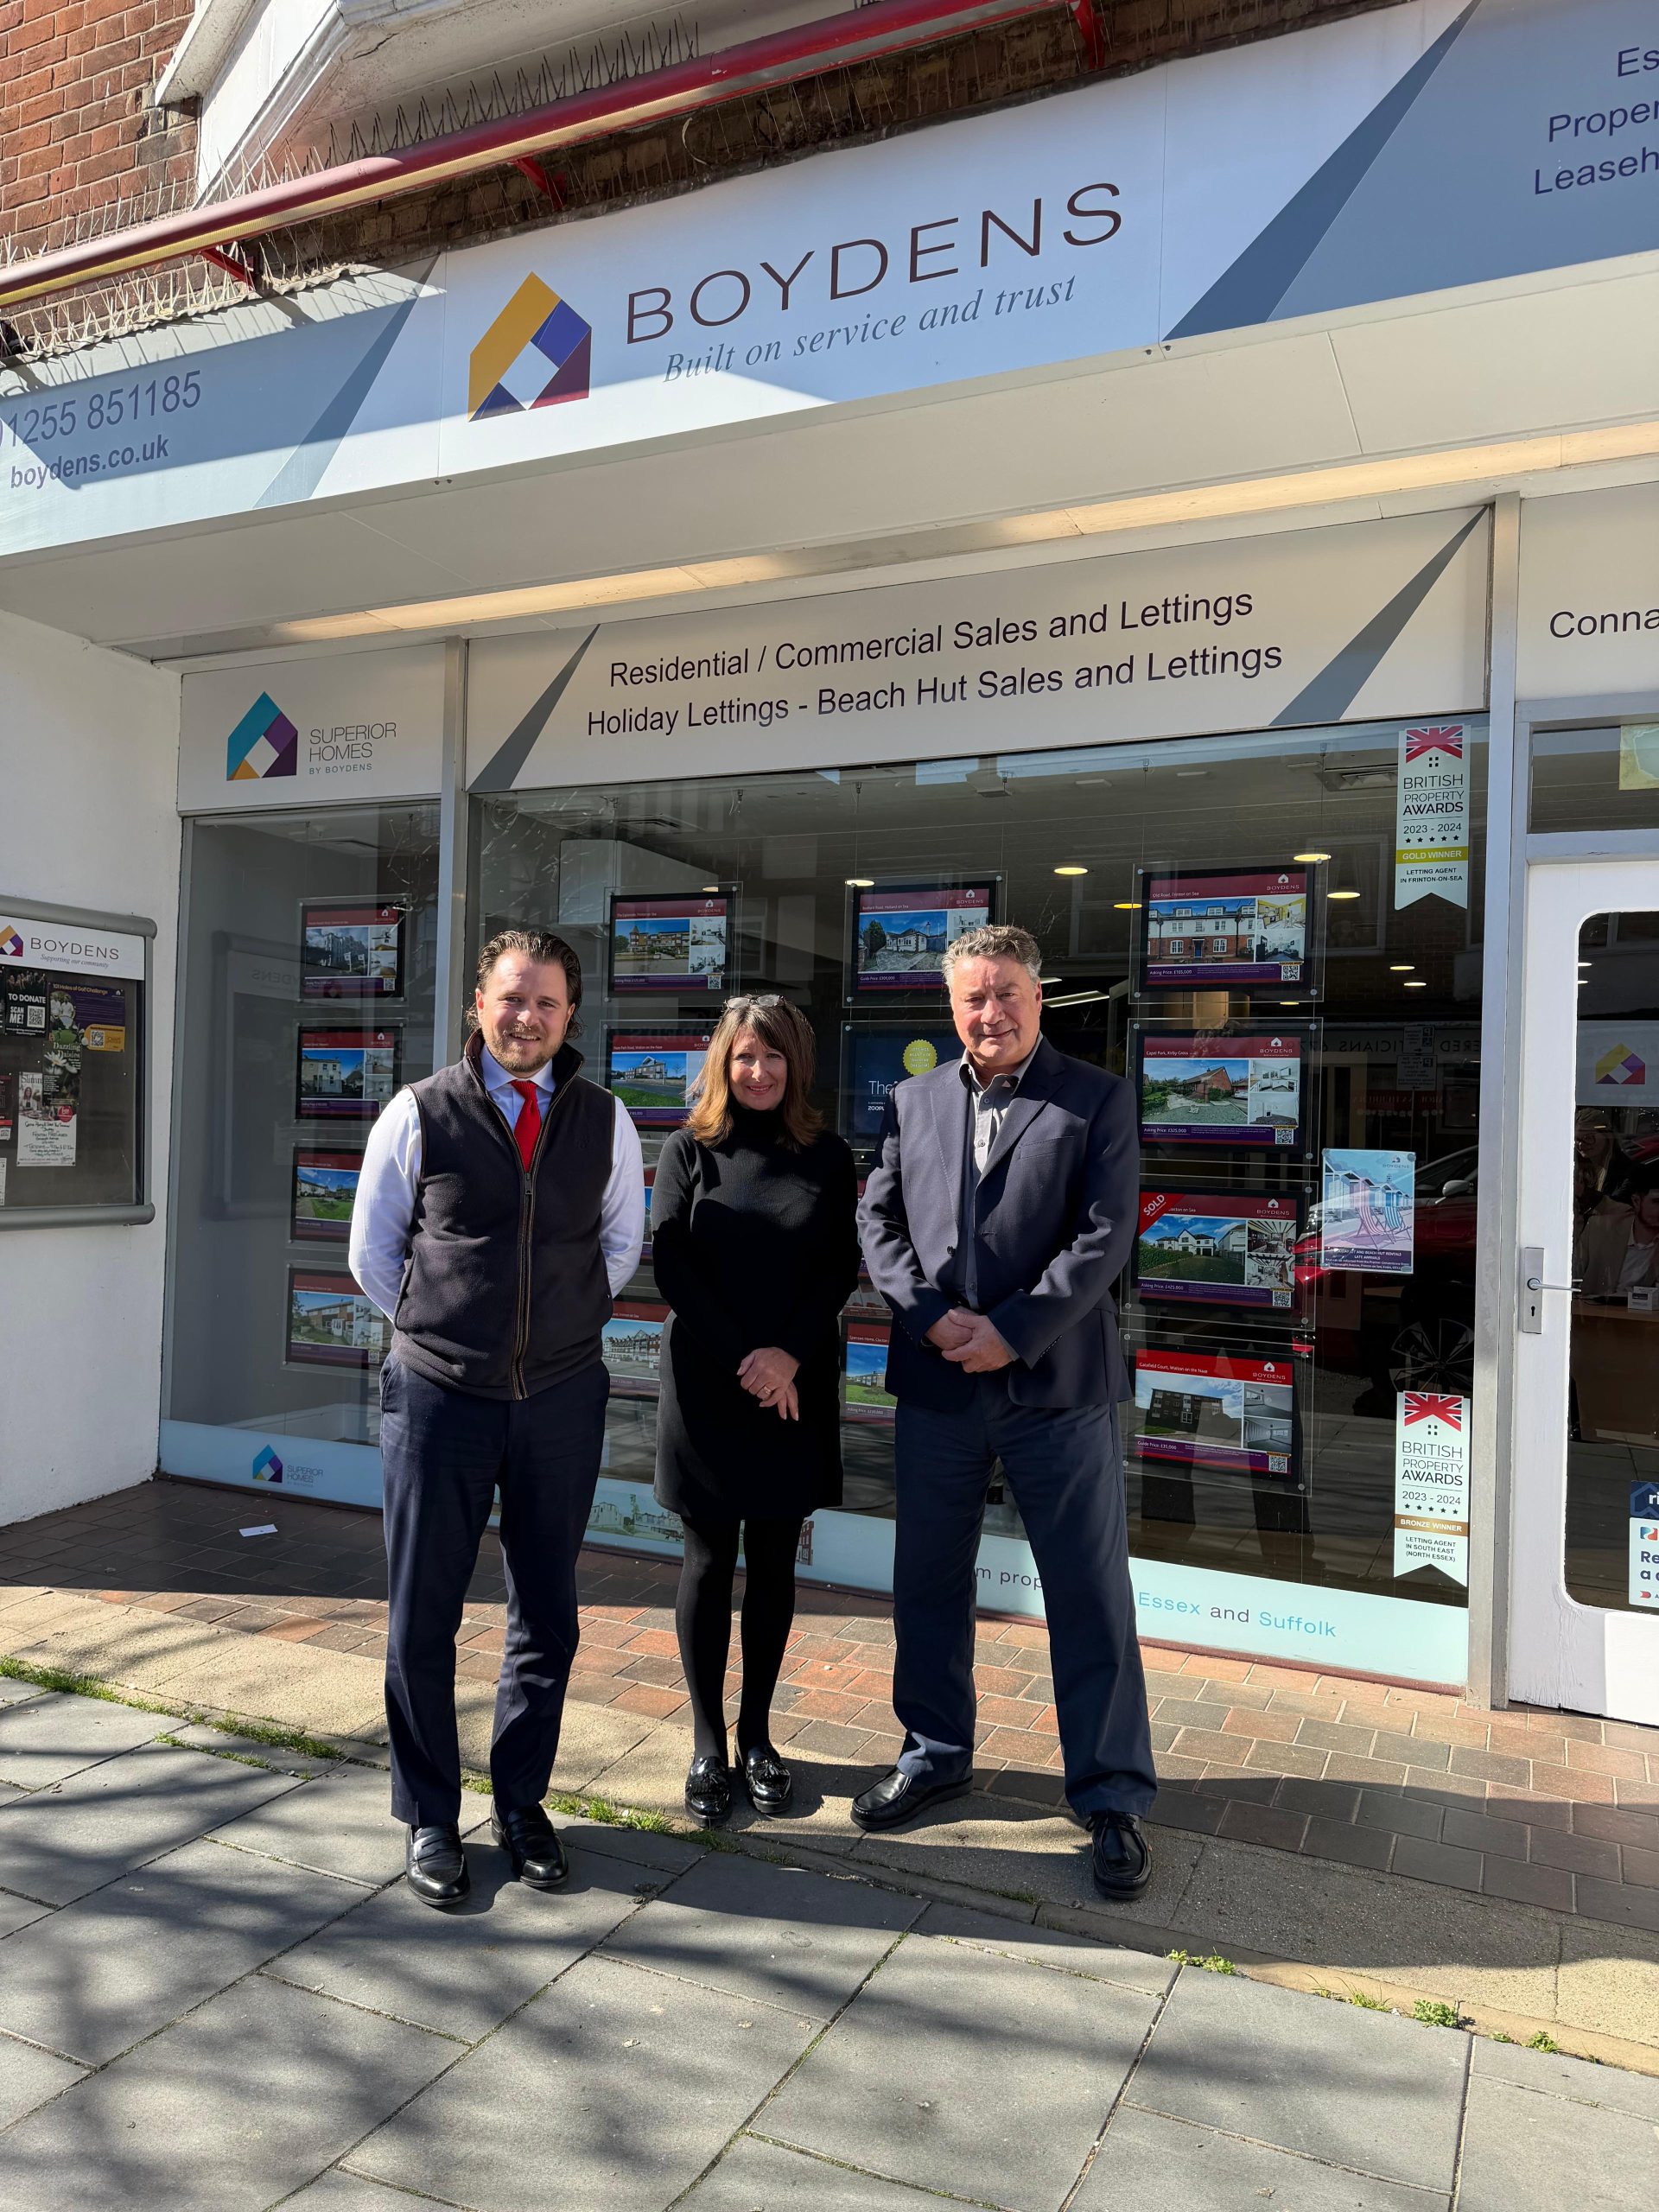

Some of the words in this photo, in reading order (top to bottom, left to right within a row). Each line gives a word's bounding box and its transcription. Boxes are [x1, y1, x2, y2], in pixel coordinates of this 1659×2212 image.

[627, 183, 1122, 344] BOYDENS
[663, 343, 734, 383] Built
[746, 339, 781, 365] on
[794, 314, 906, 357] service
[919, 290, 984, 331] and
[995, 276, 1076, 316] trust
[0, 397, 76, 447] 1255
[86, 371, 202, 429] 851185
[10, 434, 169, 489] boydens.co.uk
[1550, 608, 1659, 638] Conna
[611, 649, 748, 687] Residential
[758, 646, 767, 672] /
[776, 626, 942, 670] Commercial
[953, 618, 1037, 649] Sales
[1049, 605, 1108, 638] and
[1121, 593, 1253, 629] Lettings
[588, 707, 678, 736] Holiday
[688, 698, 789, 728] Lettings
[818, 682, 905, 715] Beach
[918, 675, 967, 704] Hut
[978, 668, 1063, 698] Sales
[1075, 655, 1134, 689] and
[1148, 645, 1282, 681] Lettings
[310, 722, 397, 745] SUPERIOR
[309, 742, 372, 762] HOMES
[326, 764, 372, 774] BOYDENS
[1403, 773, 1463, 789] BRITISH
[1404, 791, 1464, 803] PROPERTY
[1403, 801, 1464, 815] AWARDS
[1403, 825, 1427, 834] 2023
[1438, 823, 1462, 832] 2024
[1428, 850, 1462, 859] WINNER
[31, 938, 119, 960] BOYDENS
[20, 995, 46, 1004] DONATE
[10, 1014, 24, 1025] ME!
[1142, 1194, 1165, 1216] SOLD
[1402, 1441, 1463, 1459] BRITISH
[287, 1465, 324, 1477] SUPERIOR
[1403, 1458, 1464, 1473] PROPERTY
[1402, 1470, 1463, 1486] AWARDS
[1402, 1491, 1427, 1502] 2023
[1437, 1496, 1461, 1505] 2024
[1401, 1518, 1430, 1529] BRONZE
[1433, 1522, 1462, 1532] WINNER
[1406, 1536, 1433, 1545] LETTING
[1433, 1539, 1457, 1548] AGENT
[1432, 1554, 1456, 1562] ESSEX)
[1138, 1592, 1201, 1615] Essex
[1211, 1604, 1249, 1624] and
[1260, 1611, 1337, 1637] Suffolk
